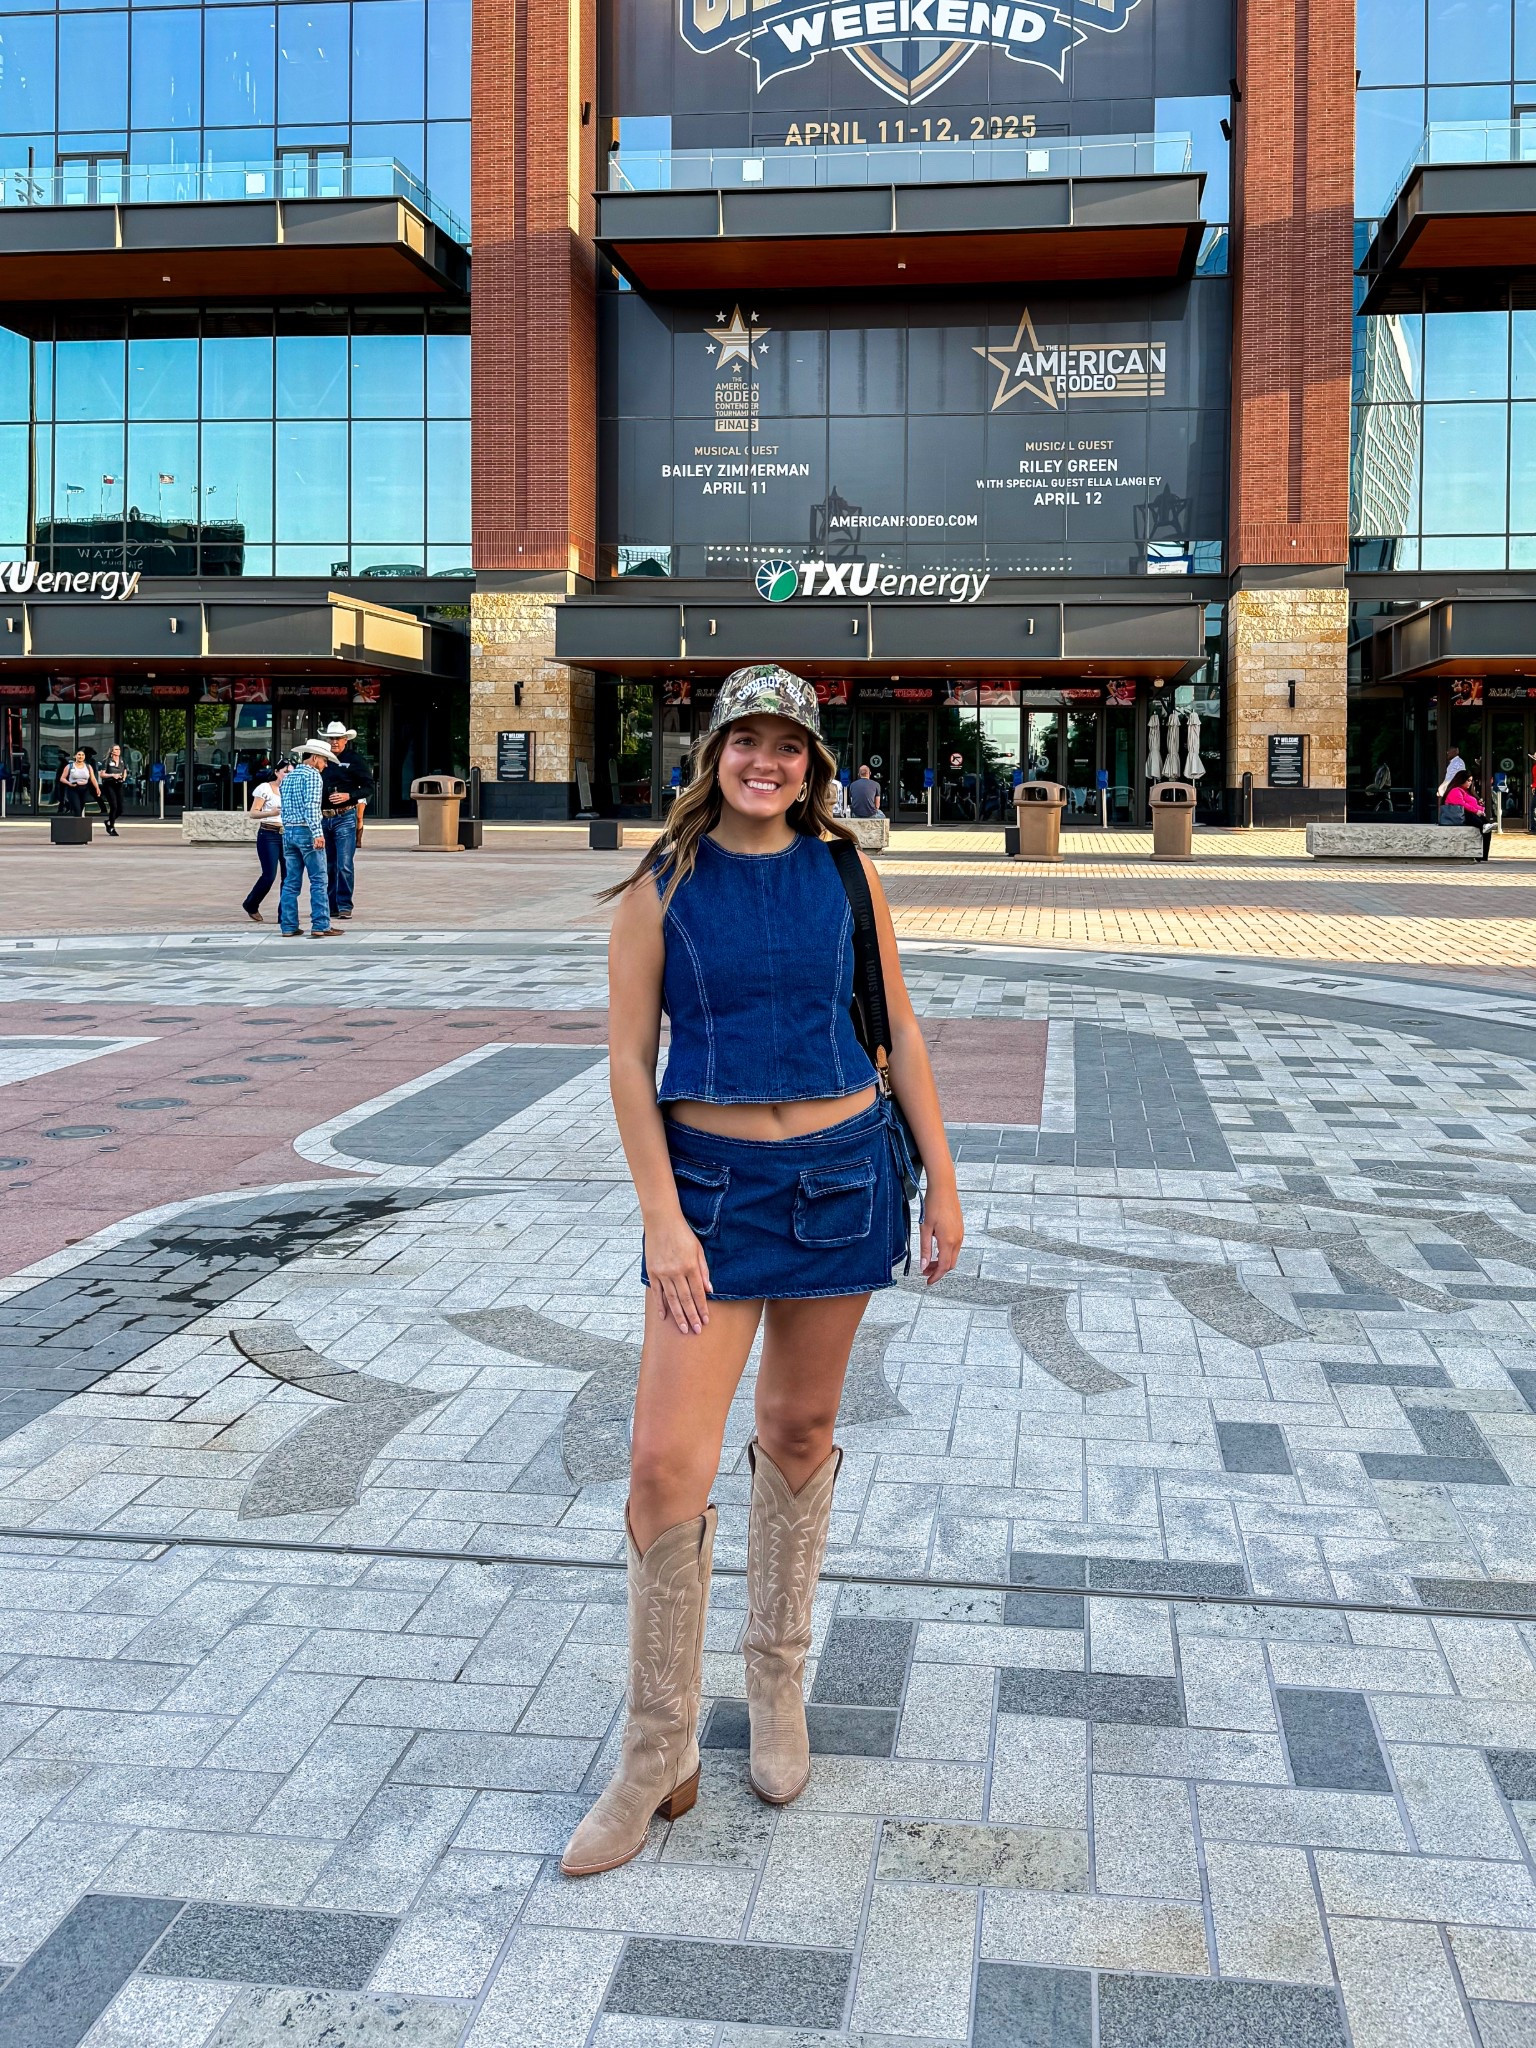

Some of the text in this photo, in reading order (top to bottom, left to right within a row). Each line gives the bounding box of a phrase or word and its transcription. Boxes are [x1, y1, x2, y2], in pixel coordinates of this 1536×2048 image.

[772, 0, 1046, 53] WEEKEND
[785, 114, 1037, 146] APRIL 11-12, 2025
[1014, 348, 1166, 377] AMERICAN
[1056, 374, 1117, 392] RODEO
[715, 390, 760, 402] RODEO
[715, 402, 760, 410] CONTENDER
[717, 419, 757, 430] FINALS
[694, 446, 742, 456] MUSICAL
[1025, 440, 1114, 452] MUSICAL GUEST
[661, 463, 810, 478] BAILEY ZIMMERMAN
[1019, 458, 1118, 474] RILEY GREEN
[702, 481, 767, 495] APRIL 11
[1006, 479, 1049, 489] SPECIAL
[1051, 478, 1085, 488] GUEST
[1087, 477, 1113, 487] ELLA
[1033, 491, 1103, 506] APRIL 12
[829, 514, 978, 528] AMERICANRODEO.COM
[37, 570, 140, 600] energy
[737, 674, 807, 707] COWBOY HAT
[894, 688, 933, 698] TEXAS
[865, 959, 885, 1045] LOUIS VUITTON
